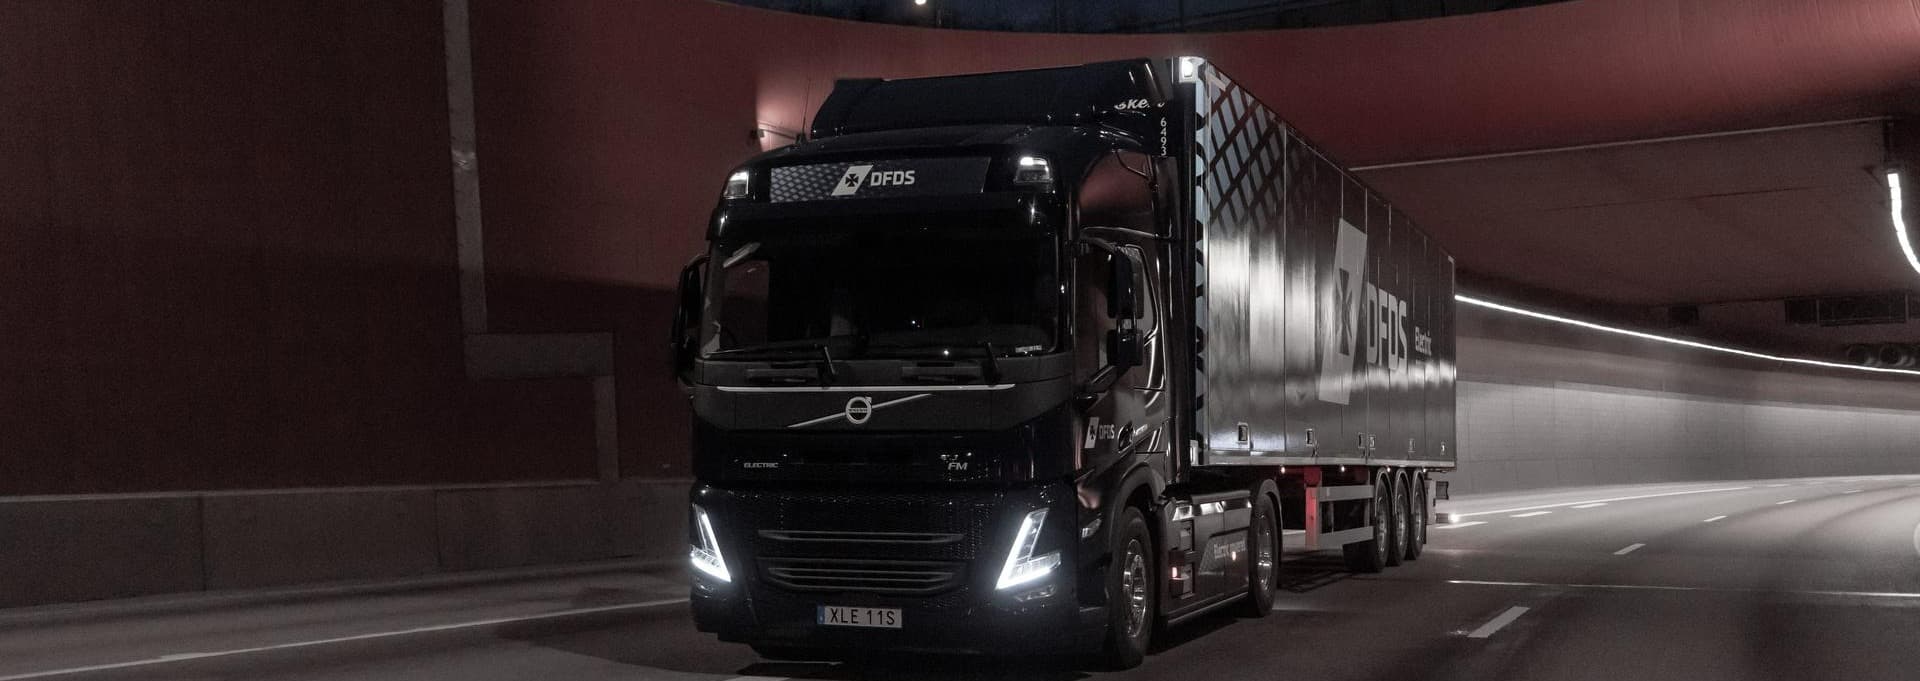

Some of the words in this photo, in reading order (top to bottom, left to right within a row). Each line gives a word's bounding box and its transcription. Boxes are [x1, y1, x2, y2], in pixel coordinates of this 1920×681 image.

[1160, 116, 1168, 156] 6493
[870, 169, 915, 187] DFDS
[1366, 281, 1407, 372] DFDS
[947, 461, 969, 471] FM
[830, 607, 859, 625] XLE
[866, 609, 895, 626] 11S
